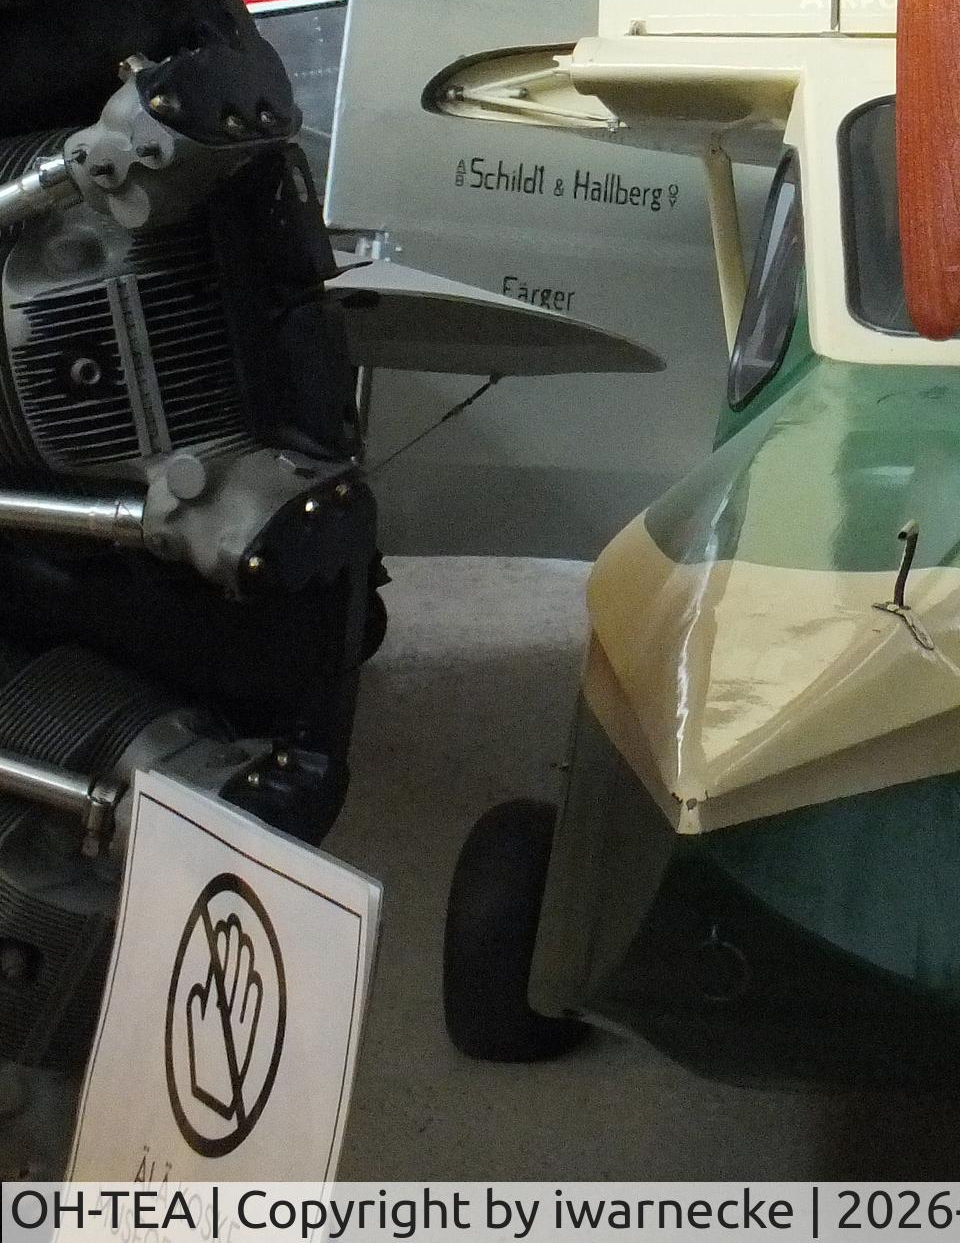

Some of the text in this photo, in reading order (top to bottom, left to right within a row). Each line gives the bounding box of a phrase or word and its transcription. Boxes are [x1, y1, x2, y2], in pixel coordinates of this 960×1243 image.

[469, 157, 545, 195] Schildt
[553, 178, 565, 197] &
[573, 169, 663, 212] Hallberg
[502, 275, 576, 312] Färger
